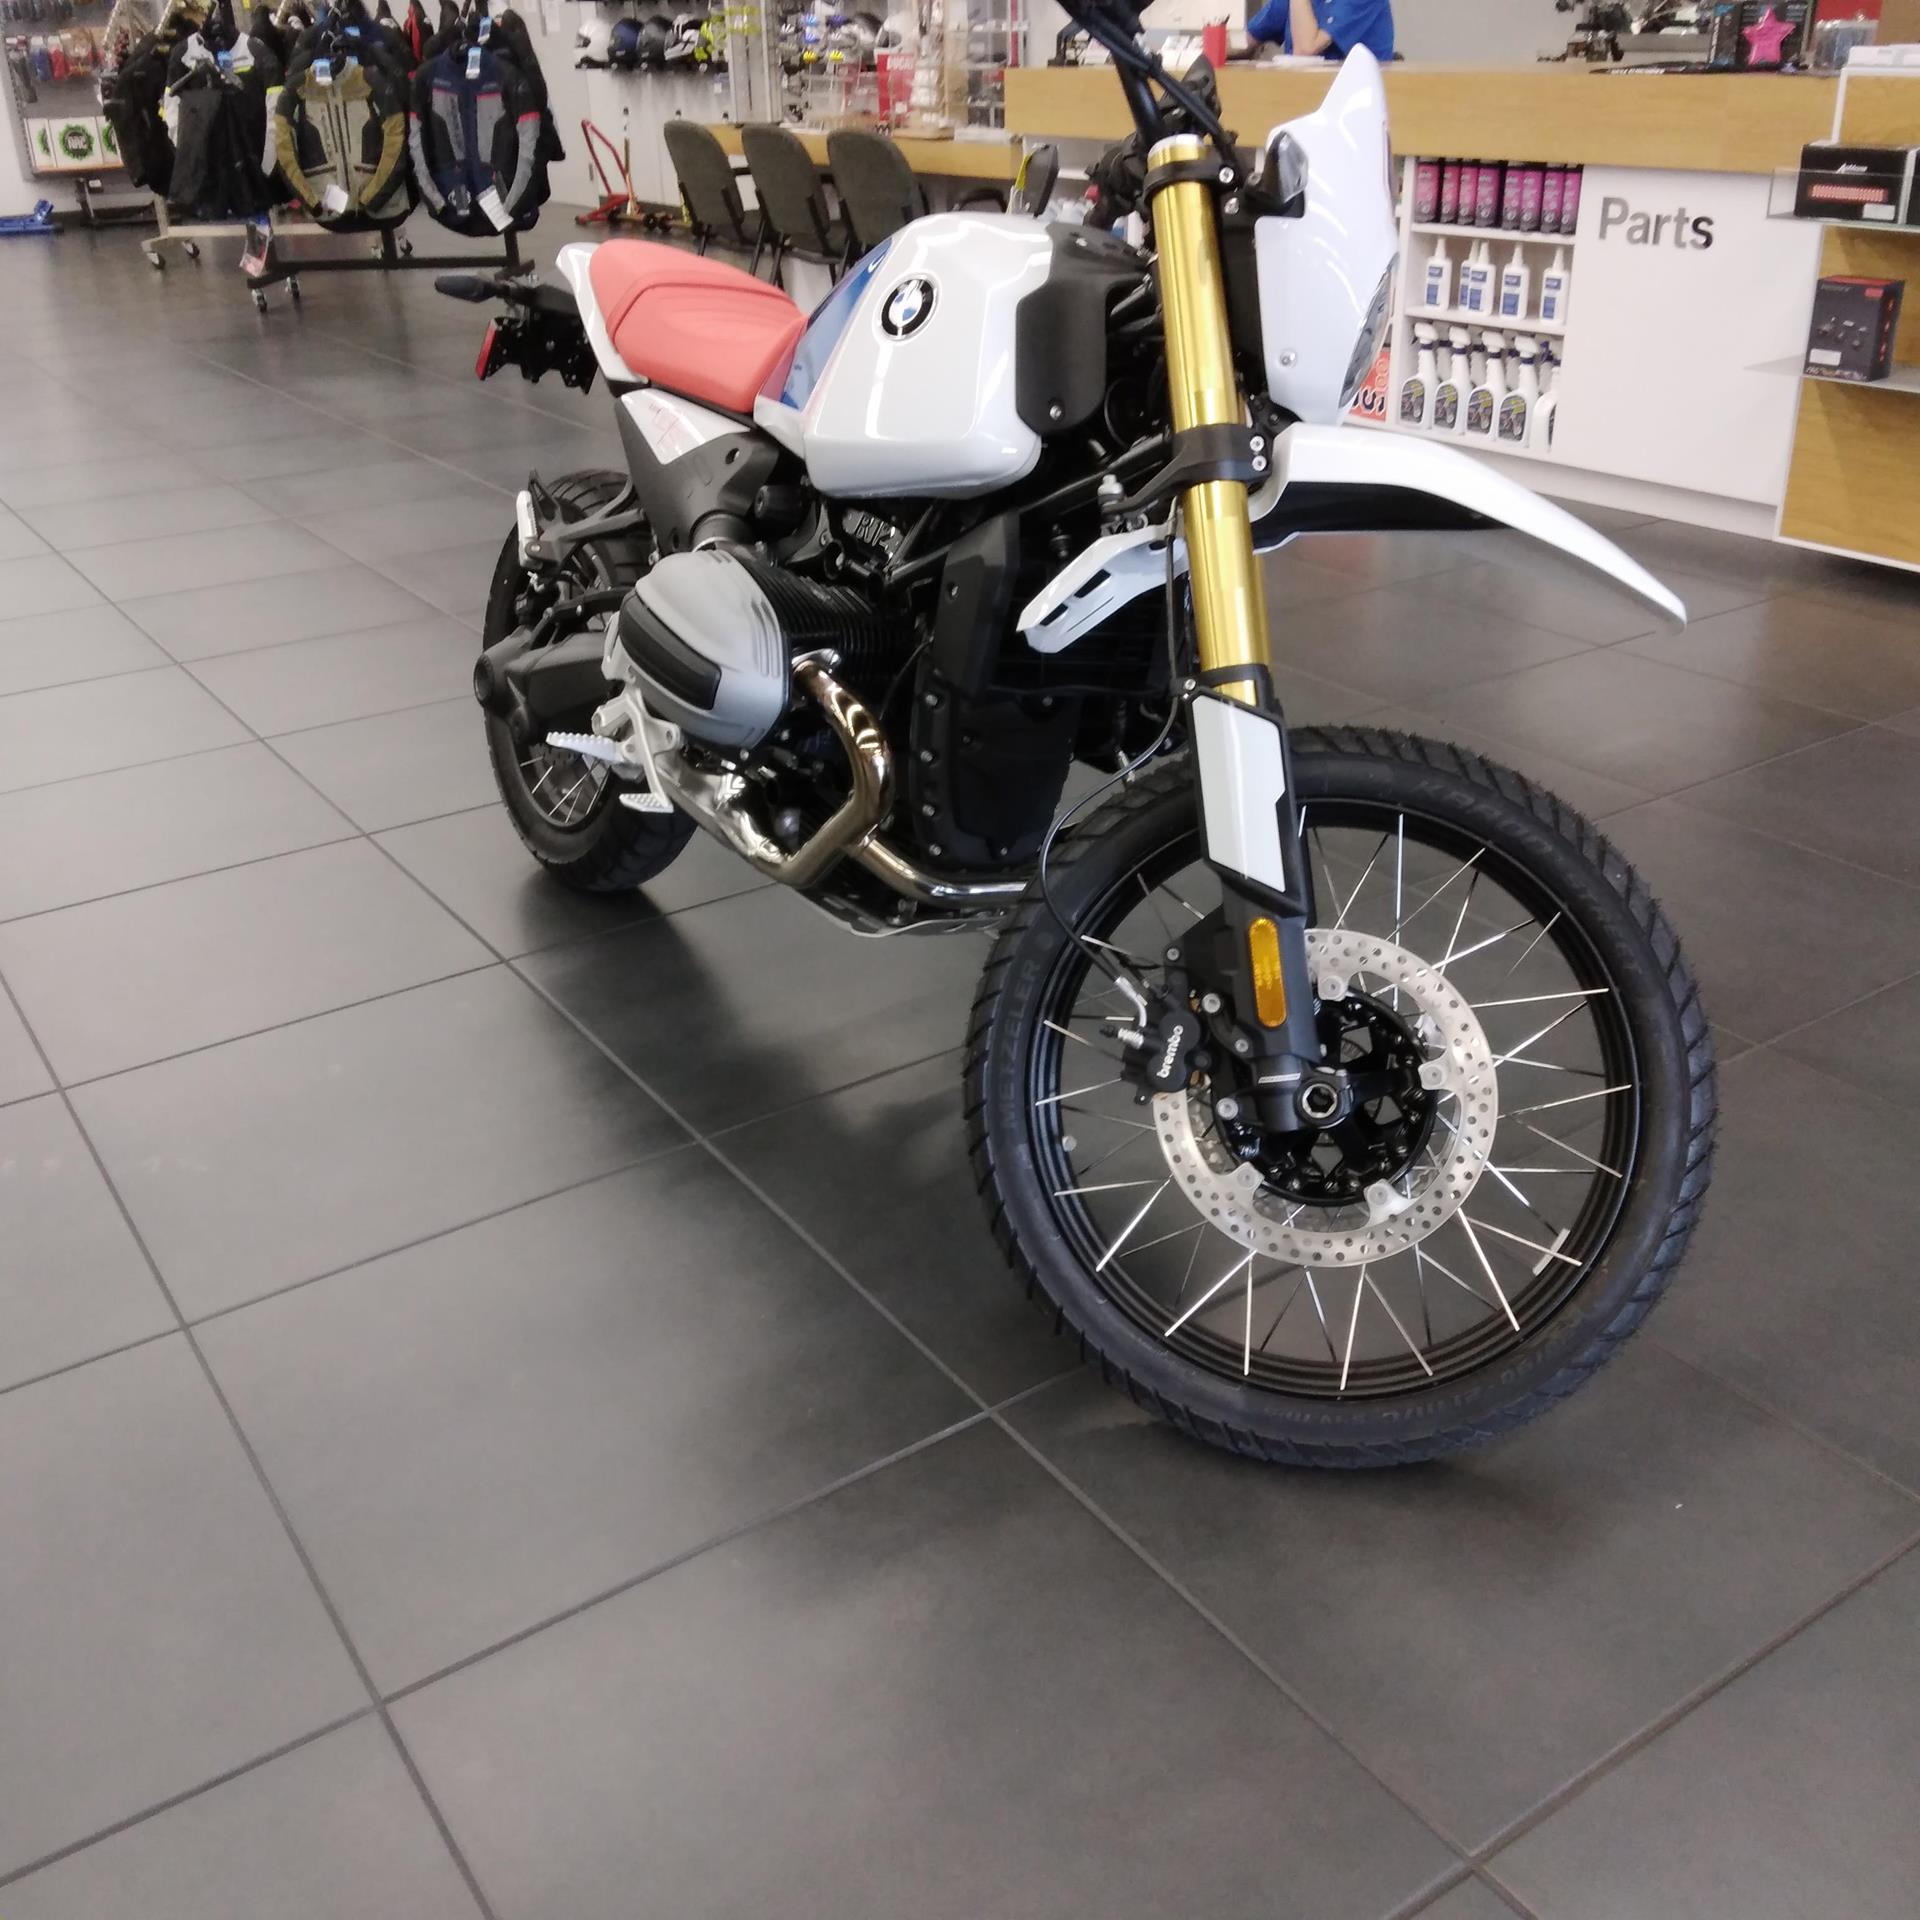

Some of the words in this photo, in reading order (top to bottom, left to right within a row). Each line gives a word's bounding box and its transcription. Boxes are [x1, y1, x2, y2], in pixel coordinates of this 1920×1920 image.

[1598, 196, 1715, 250] Parts
[996, 960, 1042, 1129] METZELER
[1156, 1024, 1184, 1079] brembo
